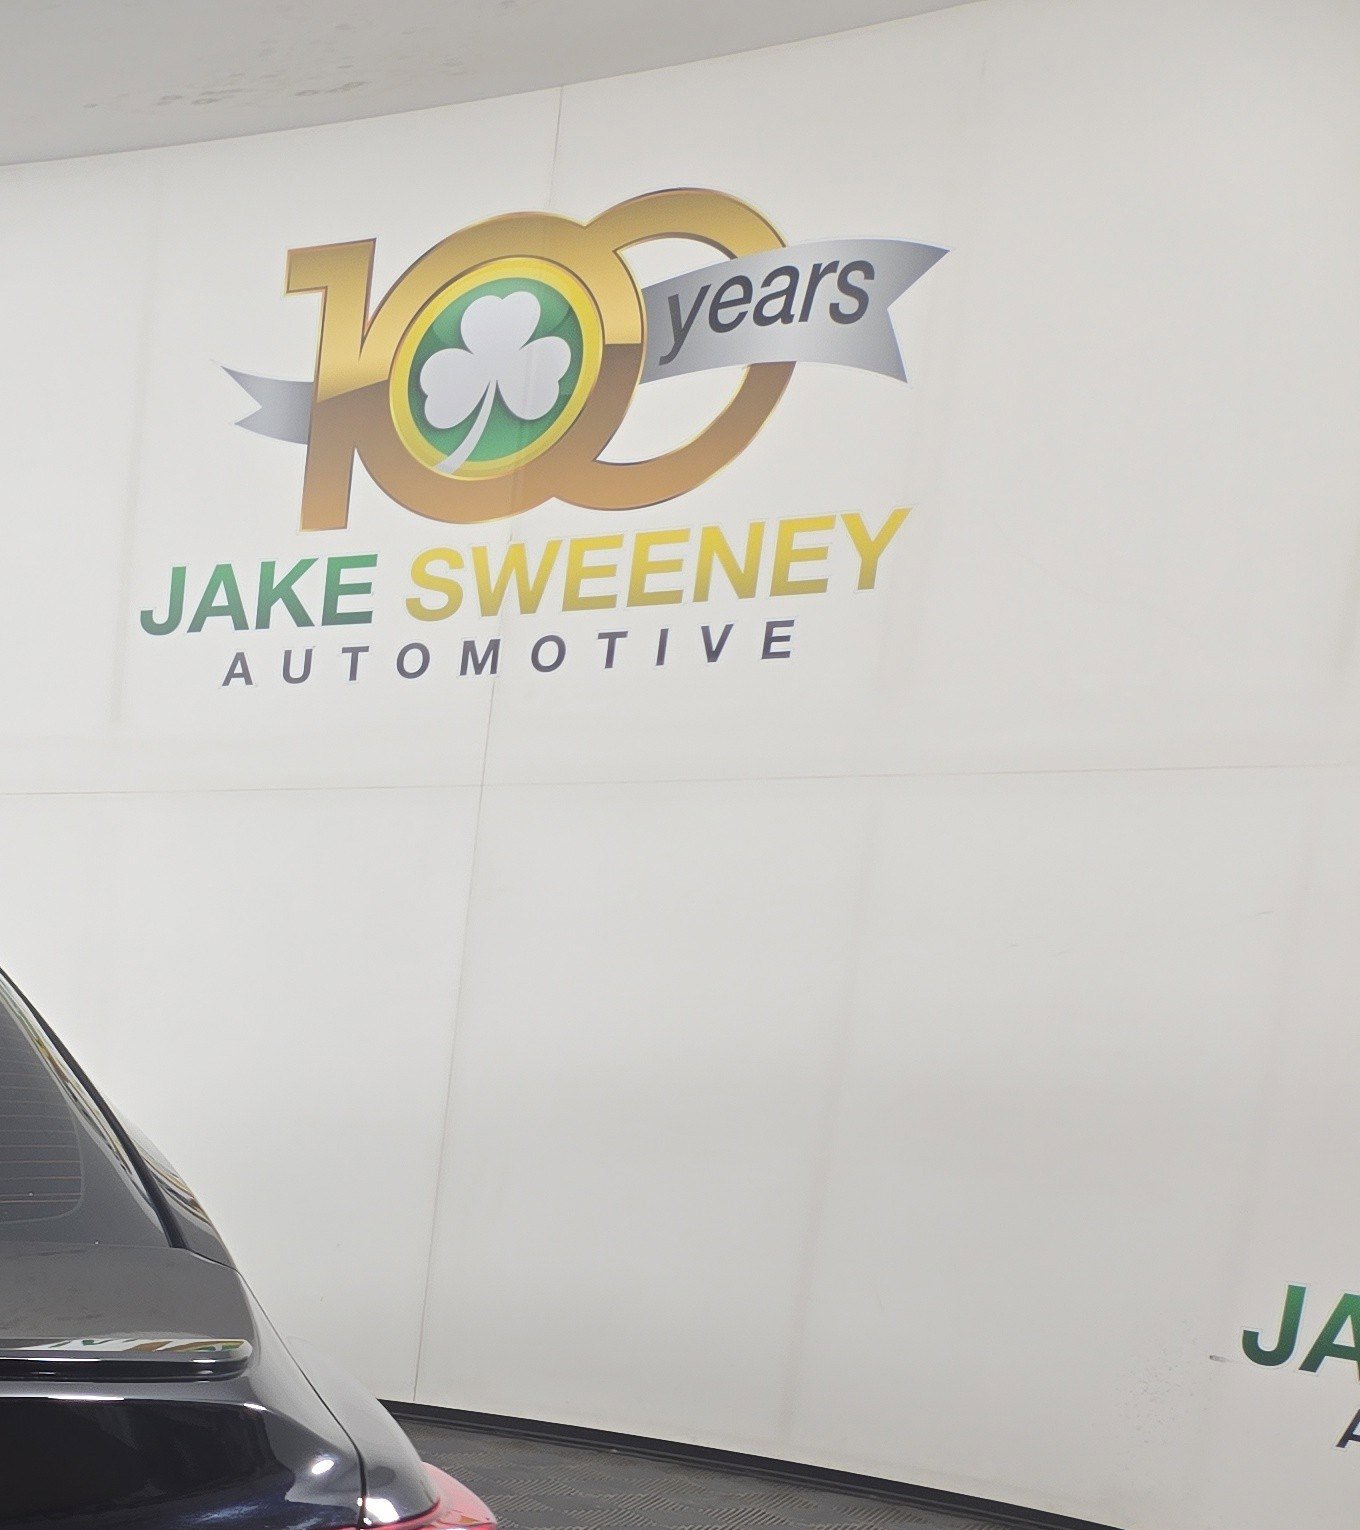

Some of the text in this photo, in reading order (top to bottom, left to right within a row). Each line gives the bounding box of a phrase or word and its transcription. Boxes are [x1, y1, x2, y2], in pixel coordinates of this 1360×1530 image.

[284, 187, 876, 533] 100 years
[140, 507, 912, 635] JAKE SWEENEY
[222, 619, 796, 687] AUTOMOTIVE
[1241, 1284, 1360, 1382] JA
